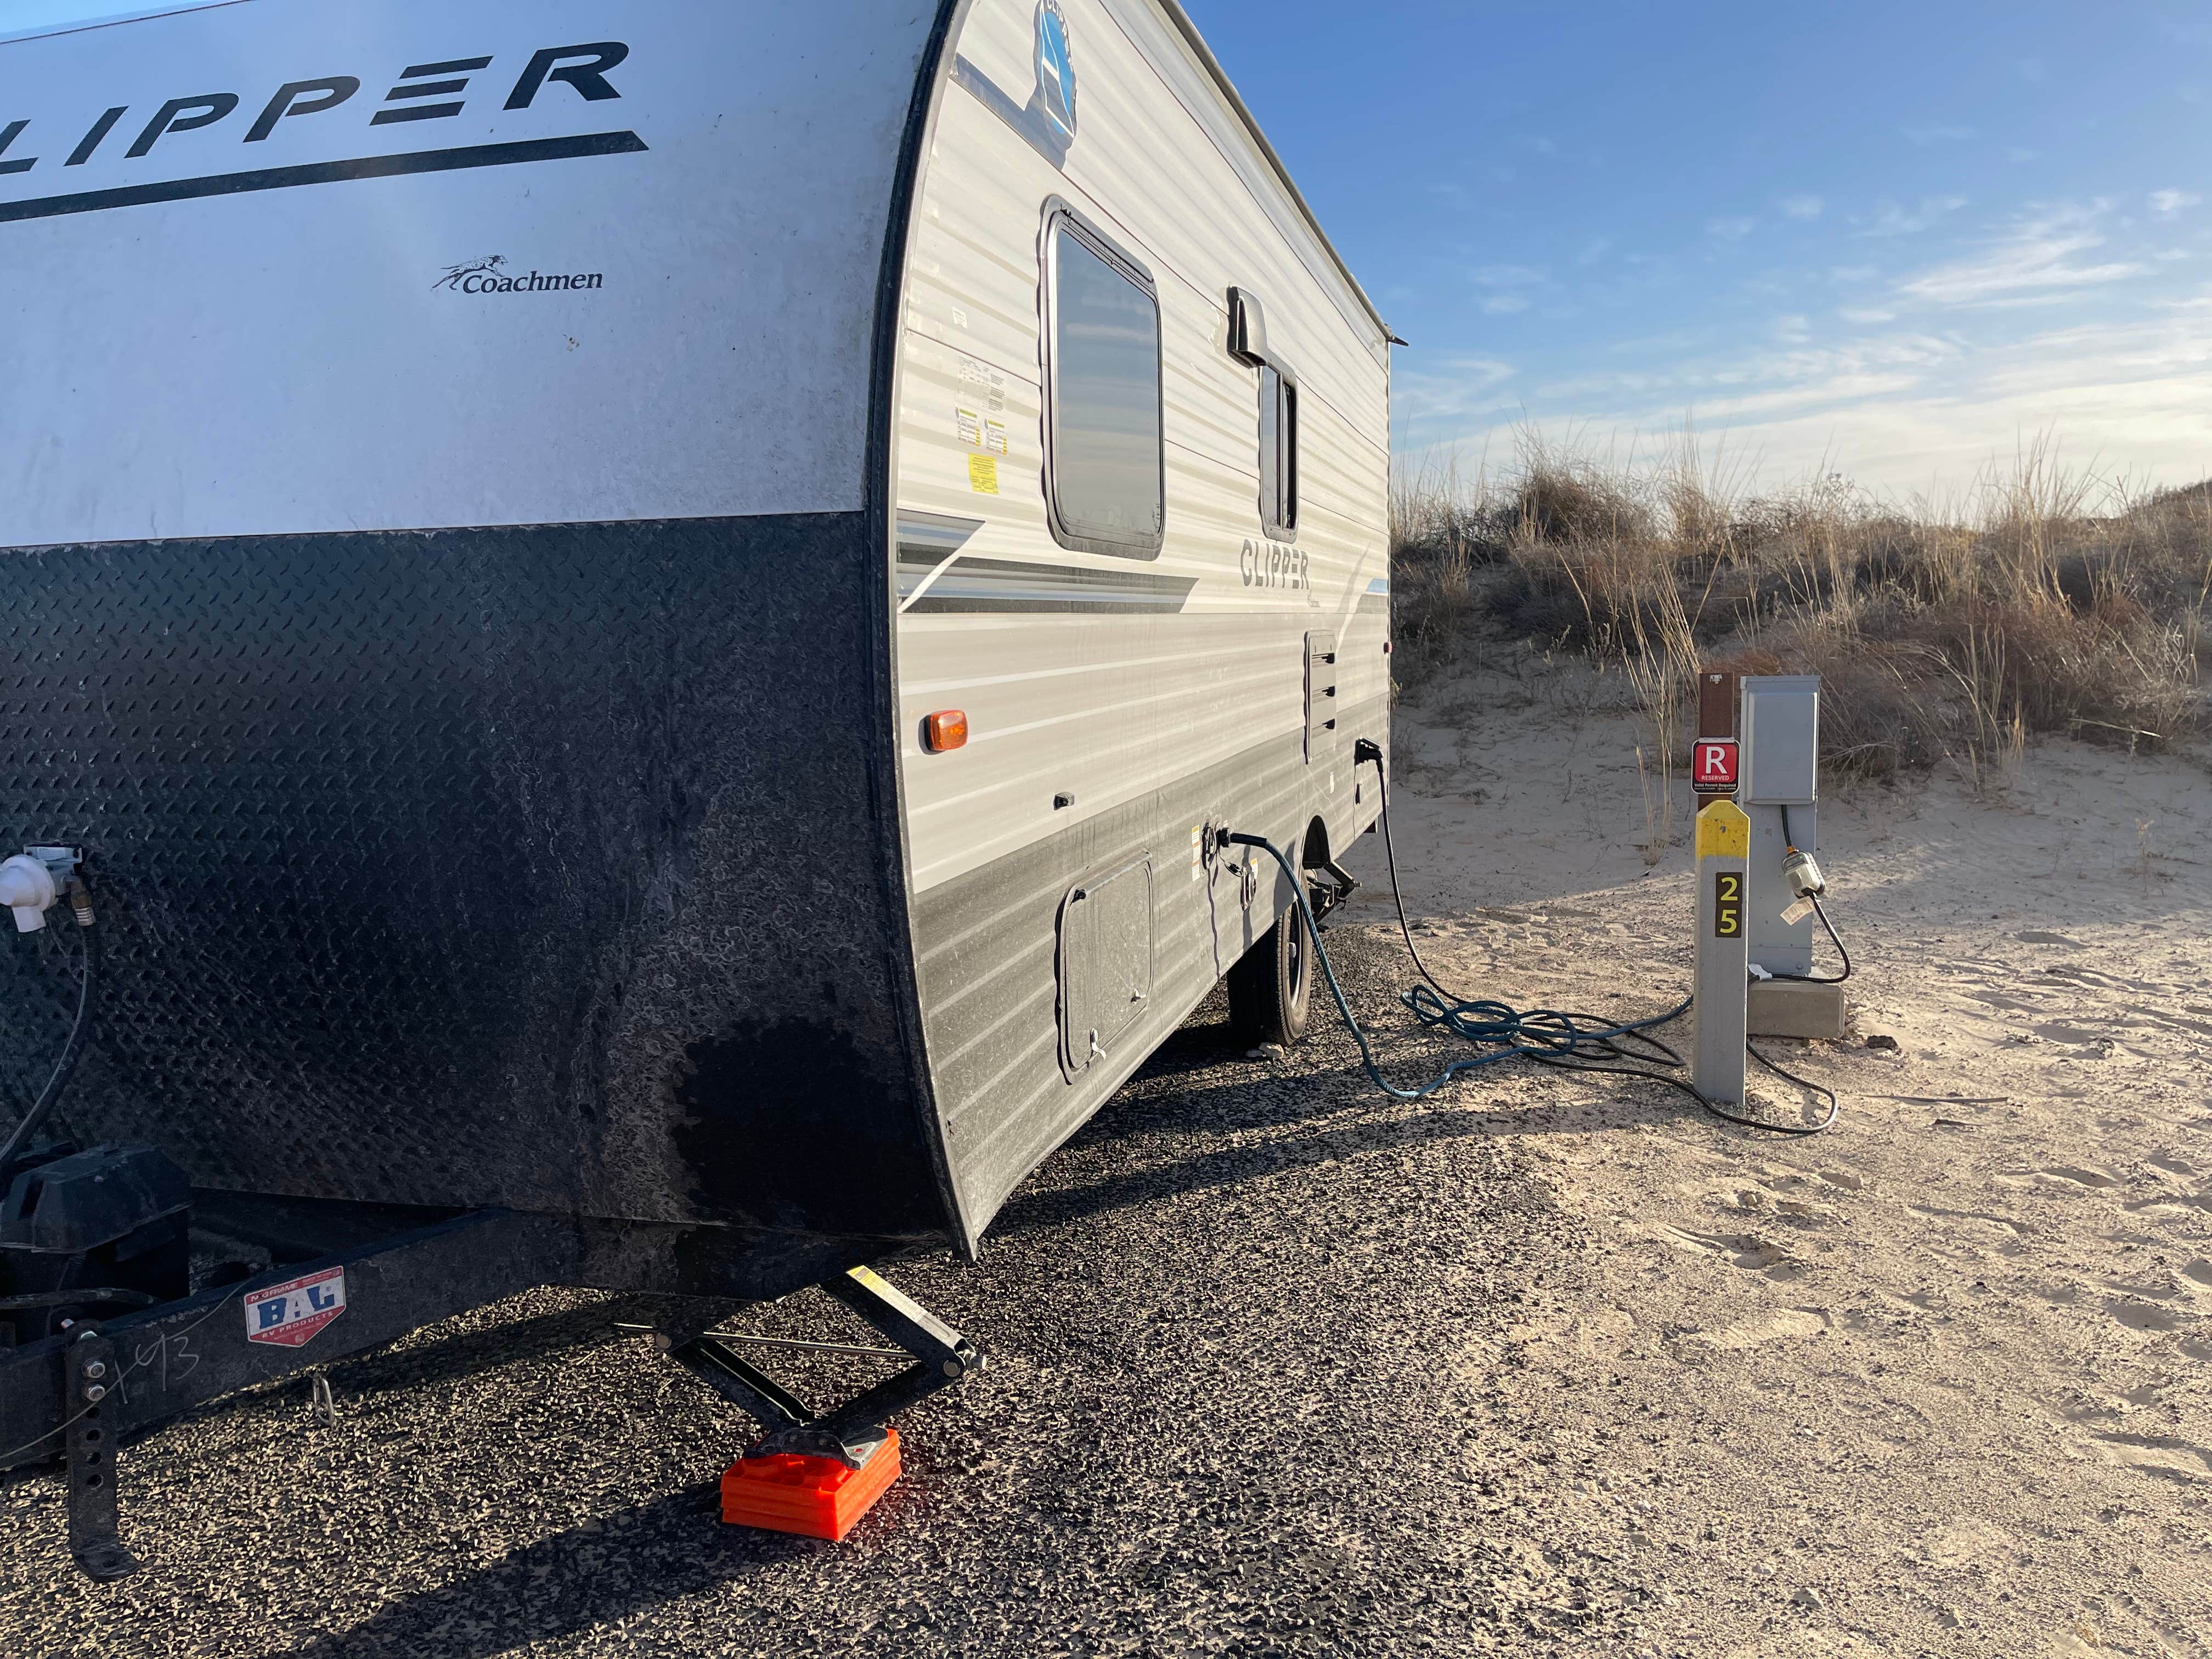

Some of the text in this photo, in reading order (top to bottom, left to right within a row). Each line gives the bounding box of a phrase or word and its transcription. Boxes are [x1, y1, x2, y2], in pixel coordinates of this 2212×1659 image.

[462, 271, 603, 294] Coachmen
[1240, 539, 1309, 590] CLIPPER
[1706, 746, 1728, 774] R
[257, 1286, 335, 1330] BAL
[279, 1311, 333, 1333] PRODUCTS
